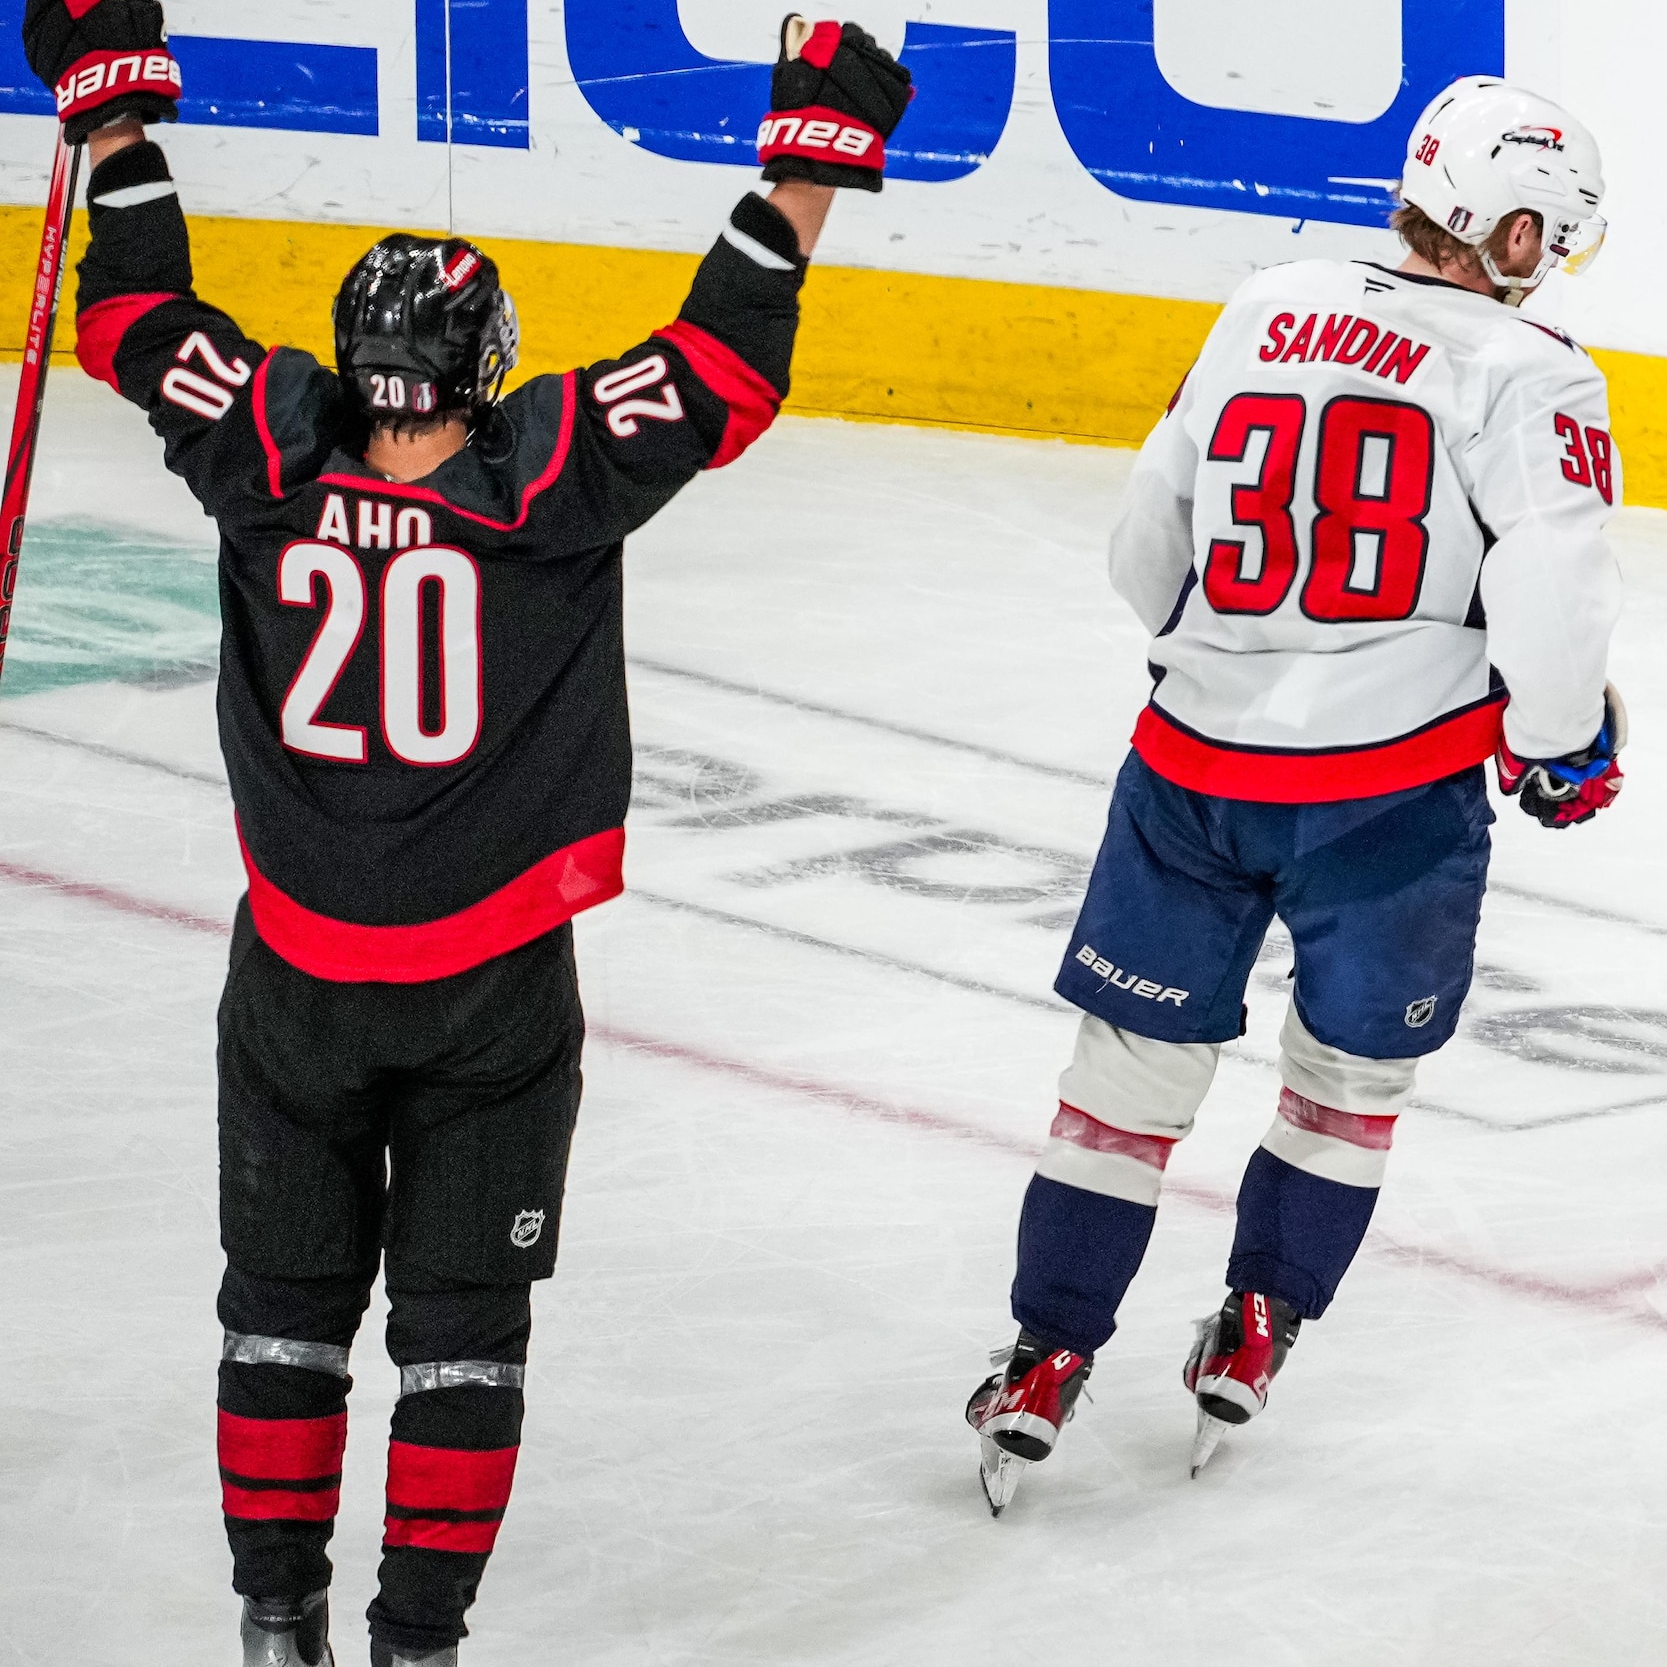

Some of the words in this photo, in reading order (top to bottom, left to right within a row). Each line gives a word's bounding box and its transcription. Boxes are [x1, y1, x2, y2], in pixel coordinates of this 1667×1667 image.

[1415, 133, 1441, 167] 38
[445, 251, 479, 290] Lenovo
[160, 330, 253, 421] 20
[1258, 311, 1431, 386] SANDIN
[369, 374, 406, 410] 20
[592, 352, 686, 439] 20
[1553, 412, 1614, 506] 38
[316, 494, 433, 550] AHO
[1202, 391, 1436, 624] 38
[276, 537, 484, 770] 20
